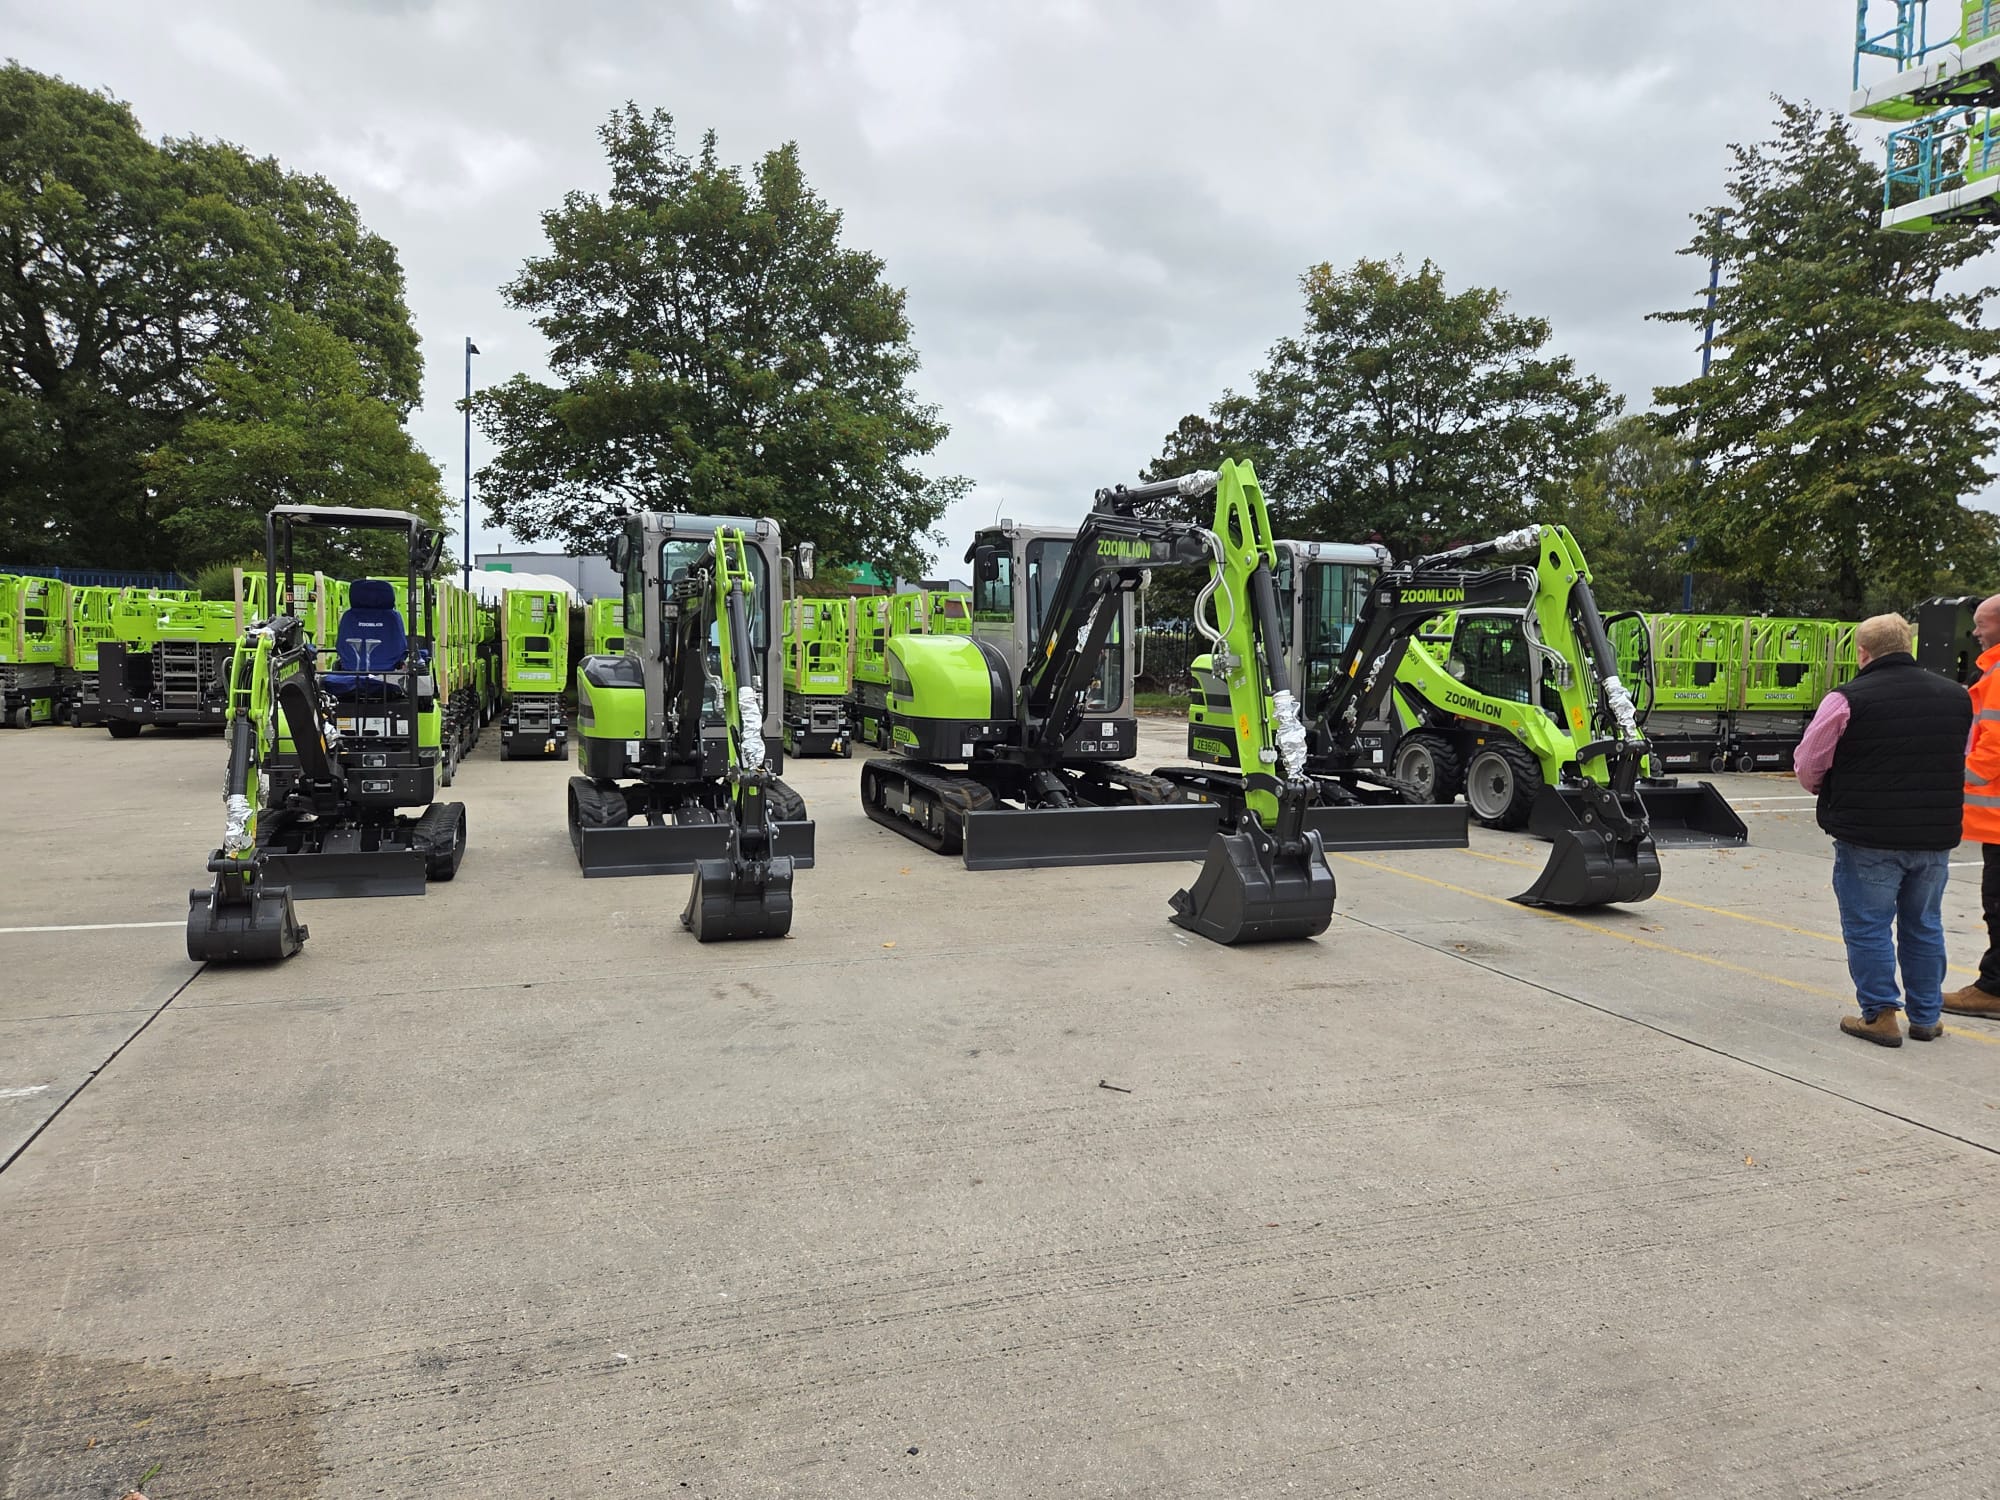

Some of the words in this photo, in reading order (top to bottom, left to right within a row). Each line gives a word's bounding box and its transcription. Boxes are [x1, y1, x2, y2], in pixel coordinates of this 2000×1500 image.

[1096, 539, 1151, 559] ZOOMLION
[1400, 587, 1465, 603] ZOOMLION
[1445, 690, 1502, 719] ZOOMLION
[1197, 739, 1221, 752] ZE36GU
